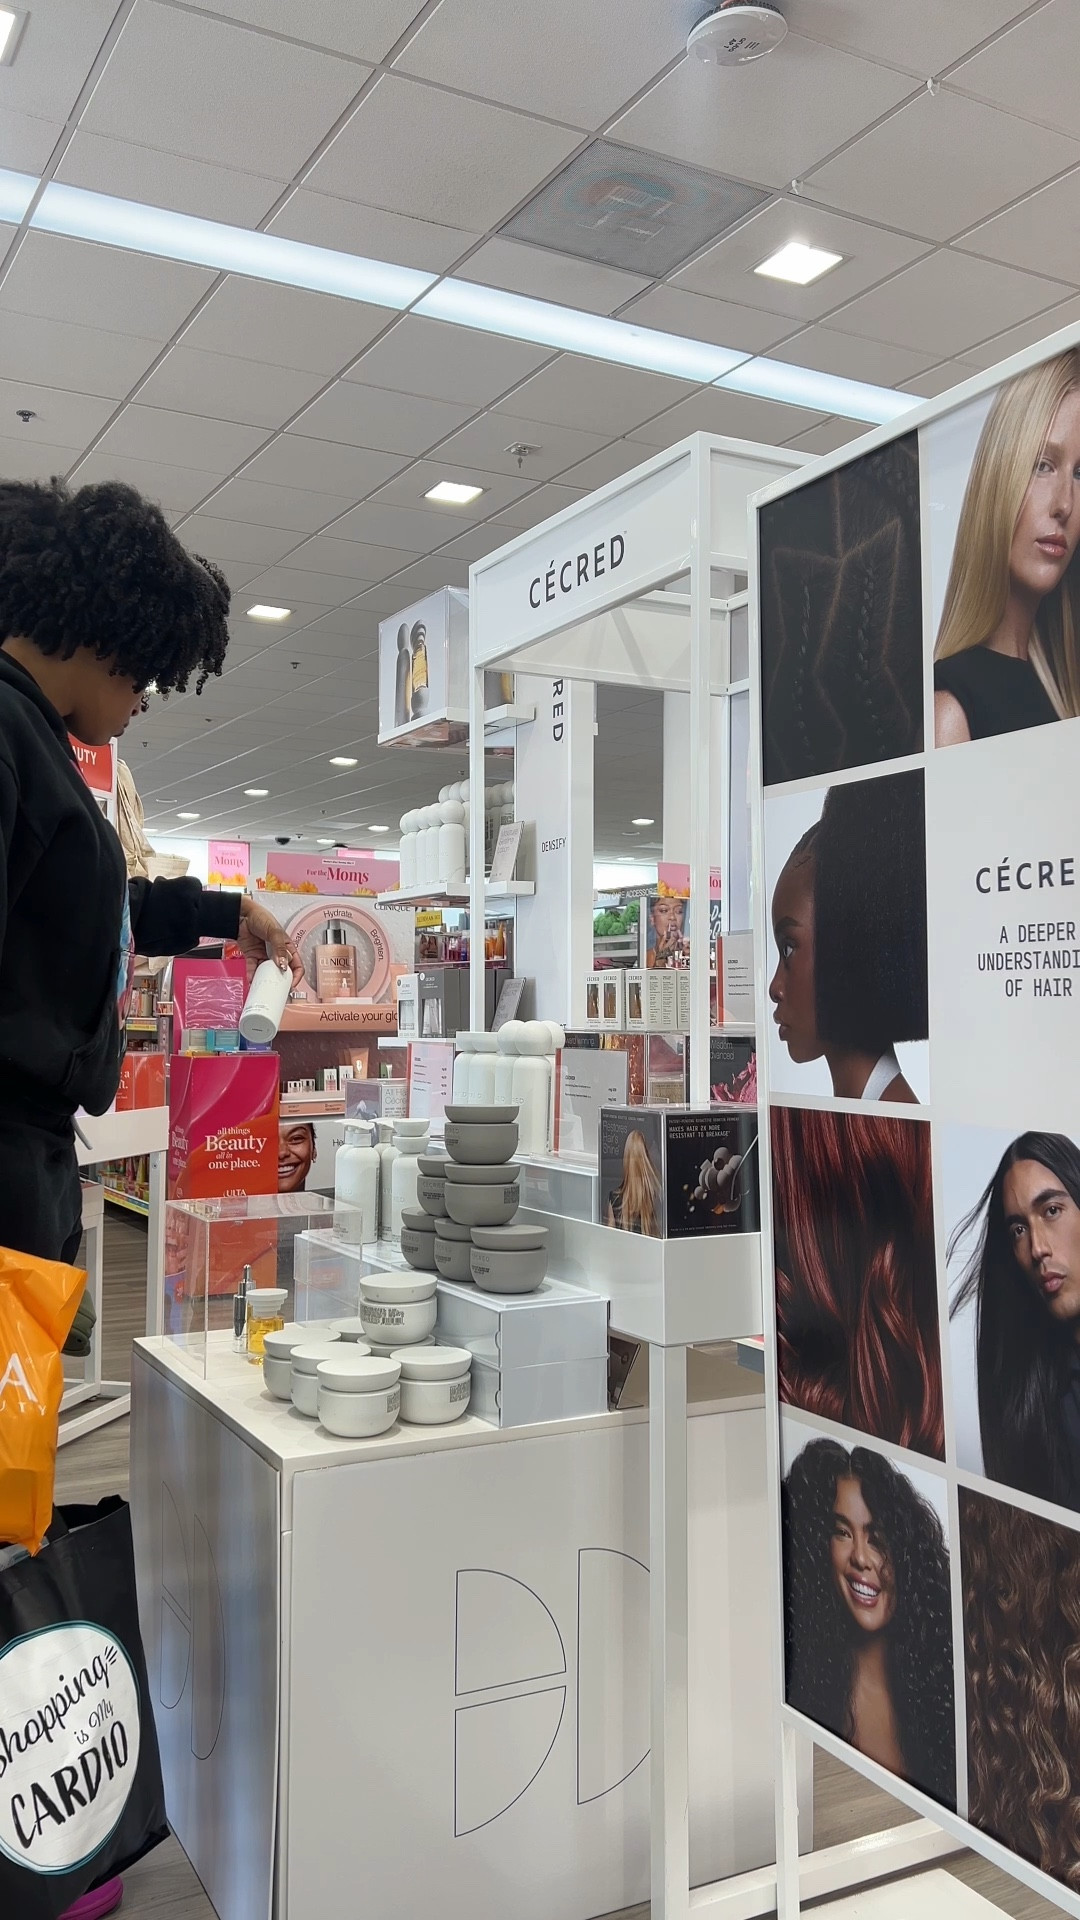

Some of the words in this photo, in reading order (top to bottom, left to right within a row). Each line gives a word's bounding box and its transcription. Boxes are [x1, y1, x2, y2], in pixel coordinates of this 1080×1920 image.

[529, 533, 626, 609] CÉCRED
[551, 678, 564, 743] RED
[214, 855, 244, 868] Moms
[327, 867, 369, 885] Moms
[976, 857, 1075, 893] CÉCRE
[323, 908, 354, 921] Hydrate.
[1000, 925, 1009, 943] A
[1018, 921, 1076, 943] DEEPER
[369, 928, 384, 962] Brighten.
[977, 949, 1080, 971] UNDERSTANDI
[1005, 978, 1023, 997] OF
[1034, 977, 1072, 997] HAIR
[319, 1010, 360, 1022] Activate
[361, 1013, 384, 1024] your
[217, 1127, 226, 1135] all
[228, 1127, 250, 1136] things
[669, 1131, 697, 1139] RESISTANT
[205, 1135, 267, 1154] Beauty
[208, 1160, 230, 1170] one
[230, 1157, 261, 1171] place.
[0, 1352, 38, 1403] A
[74, 1731, 90, 1745] is
[88, 1698, 114, 1728] My
[11, 1720, 129, 1849] CARDIO
